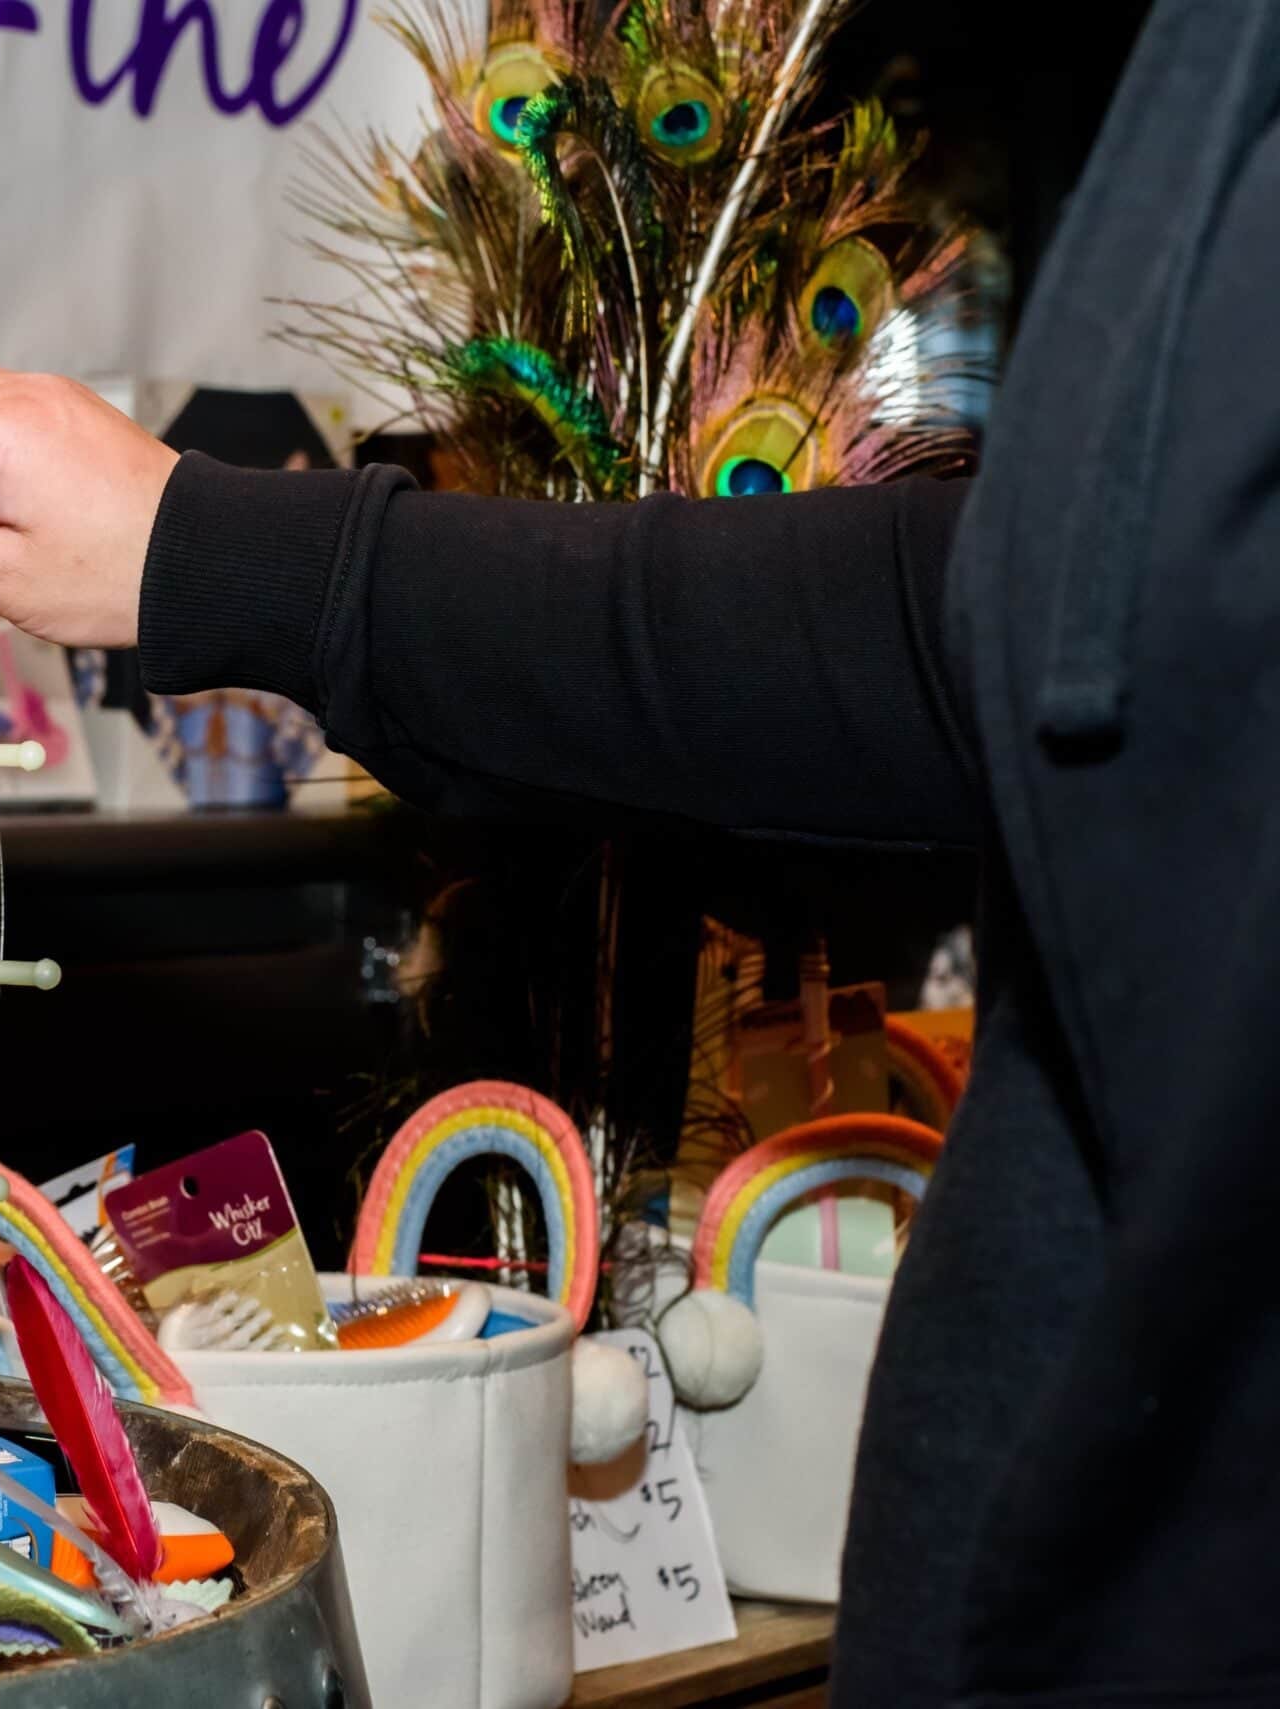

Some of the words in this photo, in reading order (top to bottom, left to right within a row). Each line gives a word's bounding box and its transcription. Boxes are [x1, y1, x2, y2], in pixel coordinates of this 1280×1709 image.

[208, 1193, 270, 1230] Whisker
[640, 1477, 682, 1522] $5
[658, 1563, 701, 1602] $5
